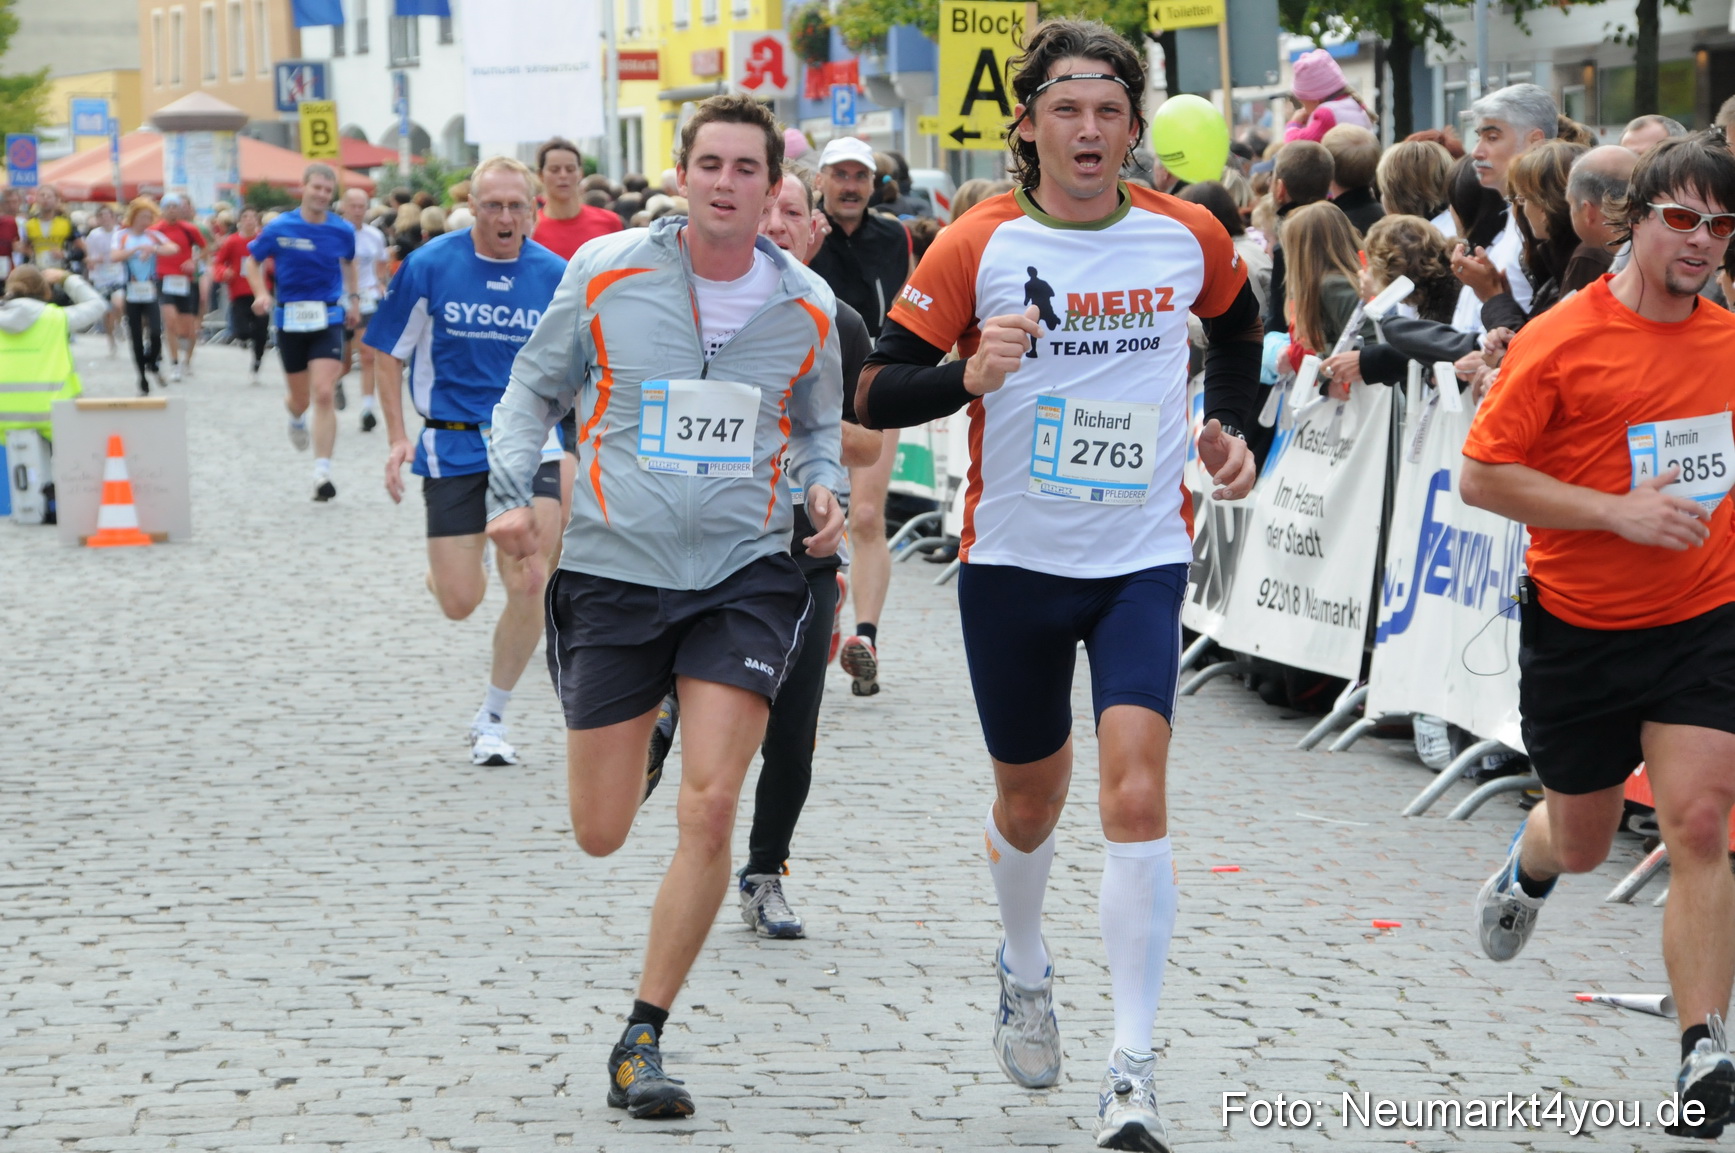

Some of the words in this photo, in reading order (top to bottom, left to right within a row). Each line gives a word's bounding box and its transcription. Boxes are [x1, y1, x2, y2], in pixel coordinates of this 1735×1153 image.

[951, 7, 1025, 35] Block
[1166, 5, 1214, 19] Toiletten
[959, 46, 1014, 118] A
[311, 118, 330, 147] B
[1066, 286, 1175, 317] MERZ
[1061, 308, 1155, 332] Reisen
[1049, 340, 1109, 356] TEAM
[1115, 336, 1161, 354] 2008
[676, 415, 745, 443] 3747
[1073, 408, 1132, 430] Richard
[1043, 432, 1050, 446] A
[1664, 428, 1699, 448] Armin
[1069, 438, 1144, 469] 2763
[709, 462, 751, 472] PFLEIDERER
[1640, 461, 1648, 475] A
[1104, 489, 1147, 499] PFLEIDERER
[1273, 476, 1293, 510] Im
[1266, 517, 1284, 551] der
[1284, 522, 1324, 559] Stadt
[1256, 577, 1301, 616] 92318
[1302, 586, 1363, 630] Neumarkt
[744, 656, 775, 677] JAKO
